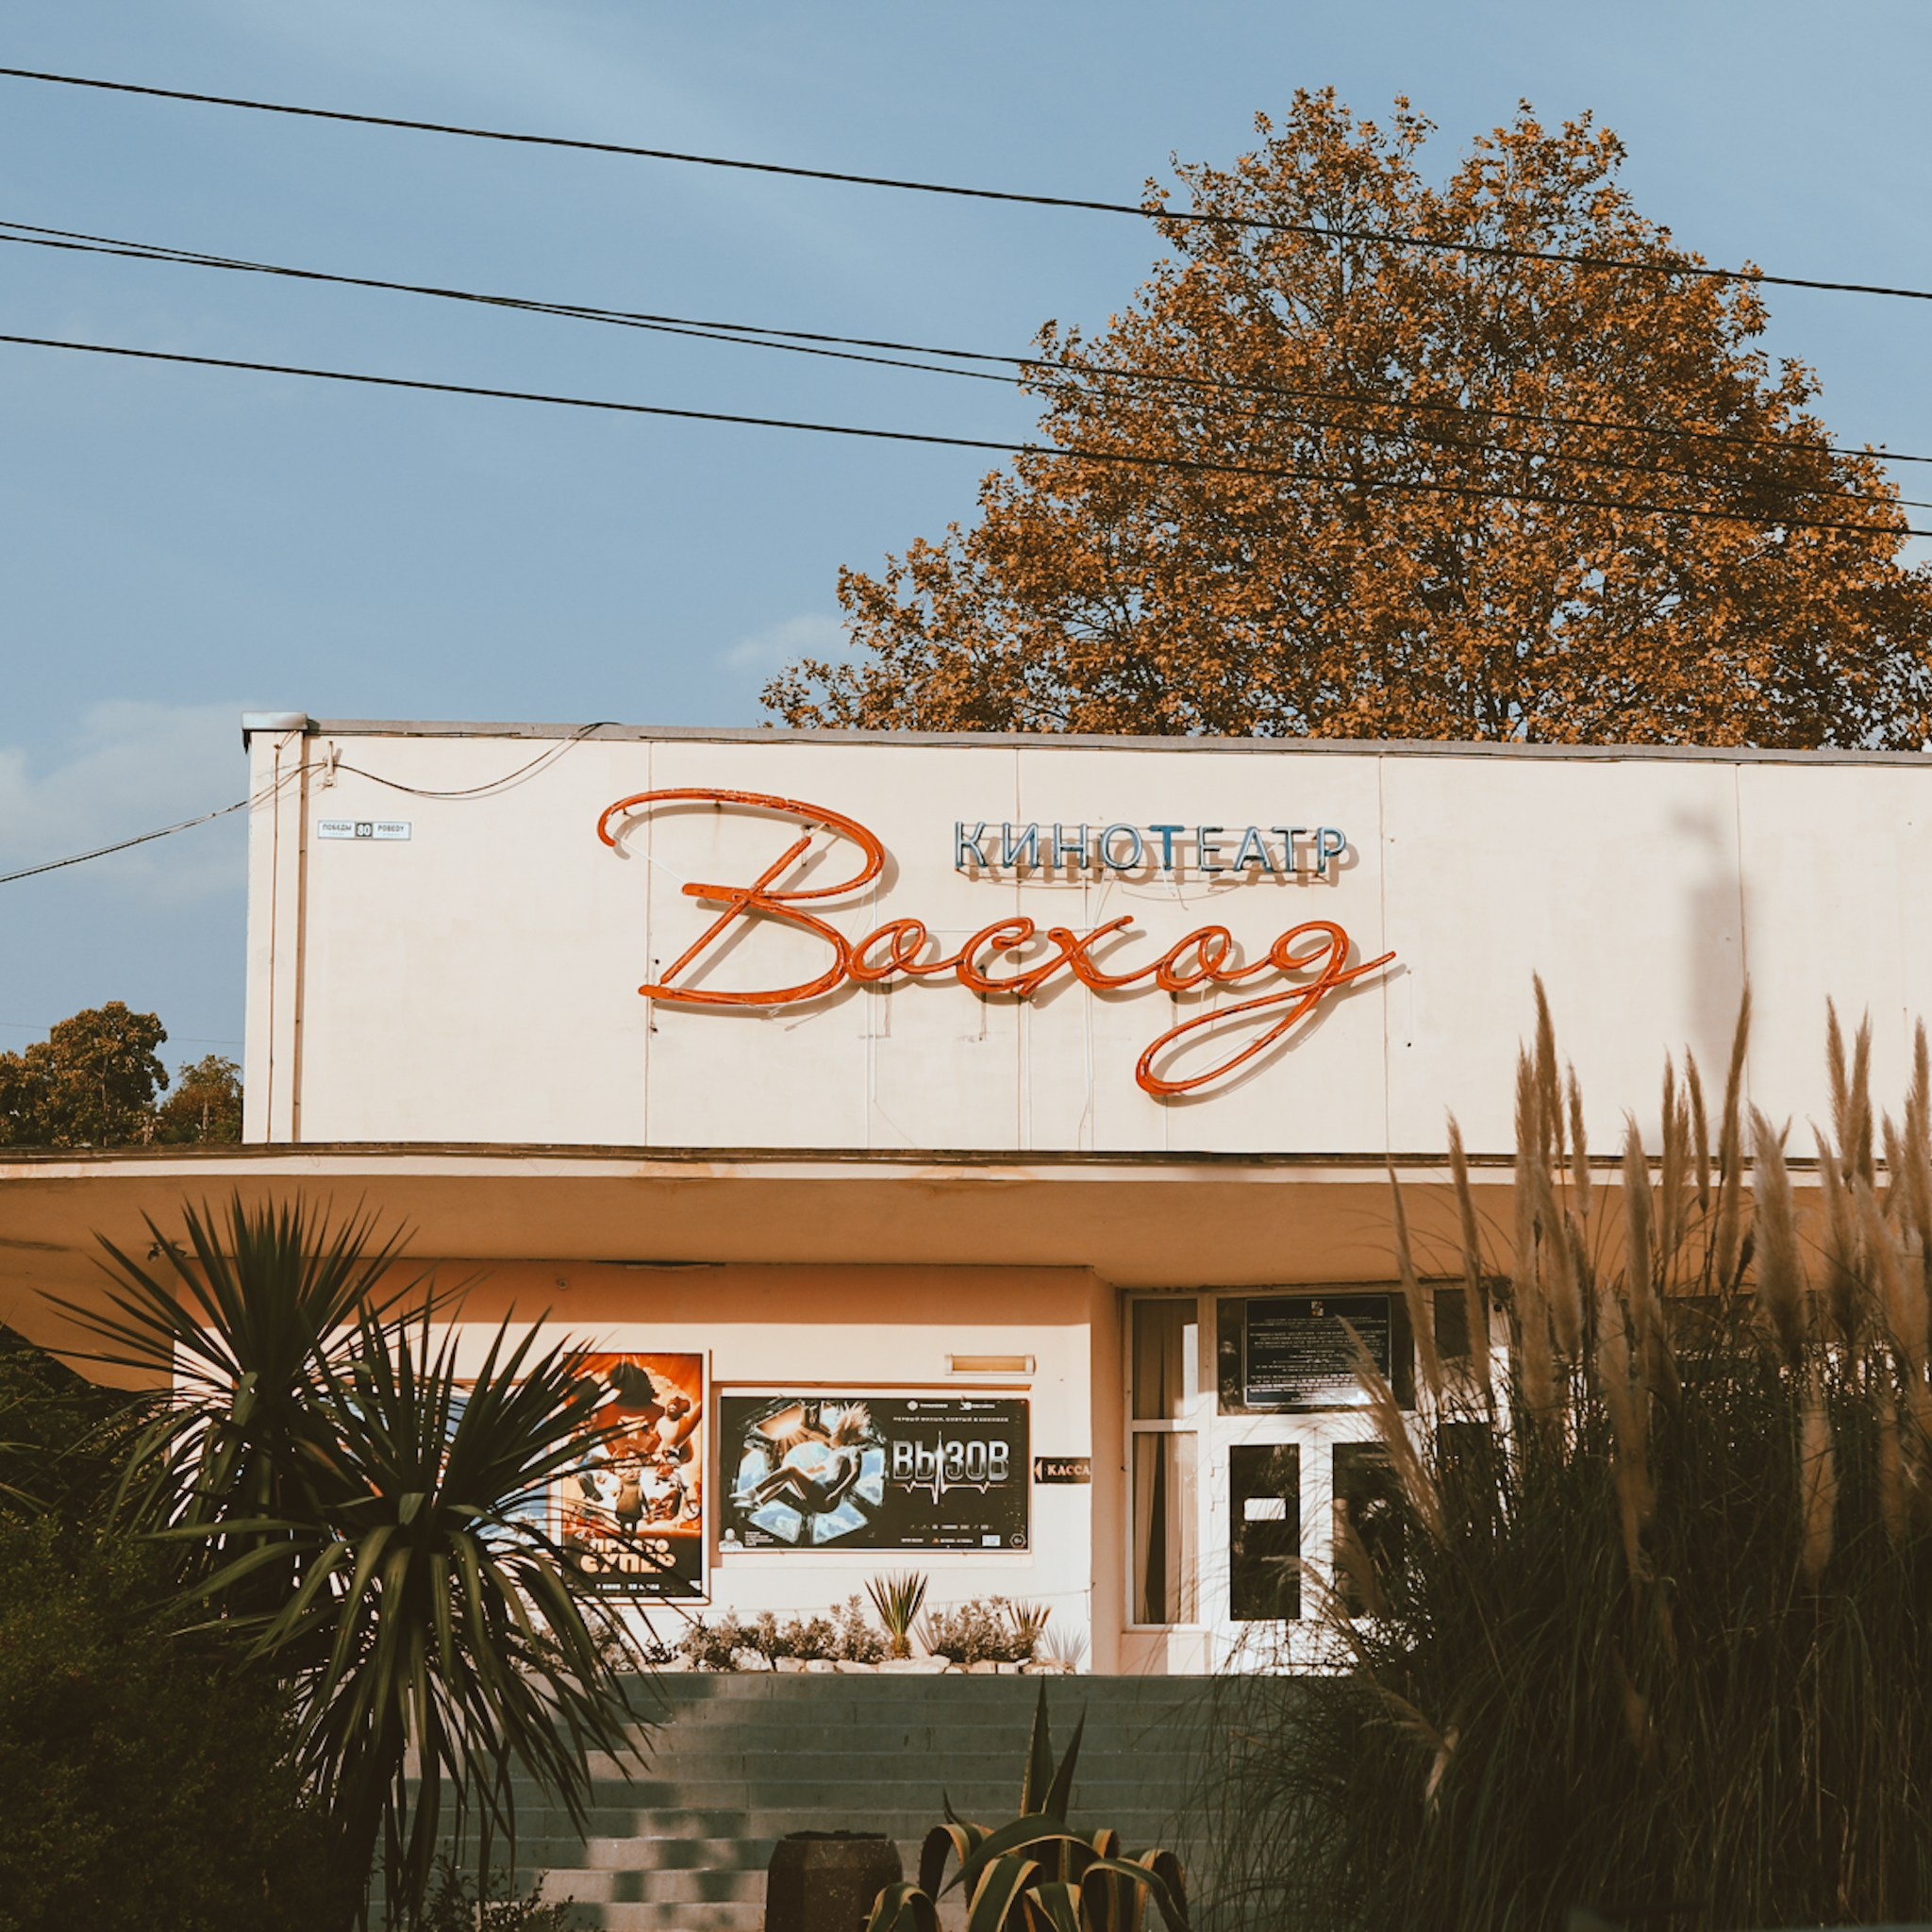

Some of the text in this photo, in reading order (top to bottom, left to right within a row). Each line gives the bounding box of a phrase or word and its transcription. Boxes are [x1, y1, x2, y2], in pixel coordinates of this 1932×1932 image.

[955, 821, 1346, 873] КИНОТЕАТР
[598, 788, 1396, 1095] Восход
[892, 1439, 1009, 1482] ВЫЗОВ
[1047, 1464, 1091, 1476] КАССА
